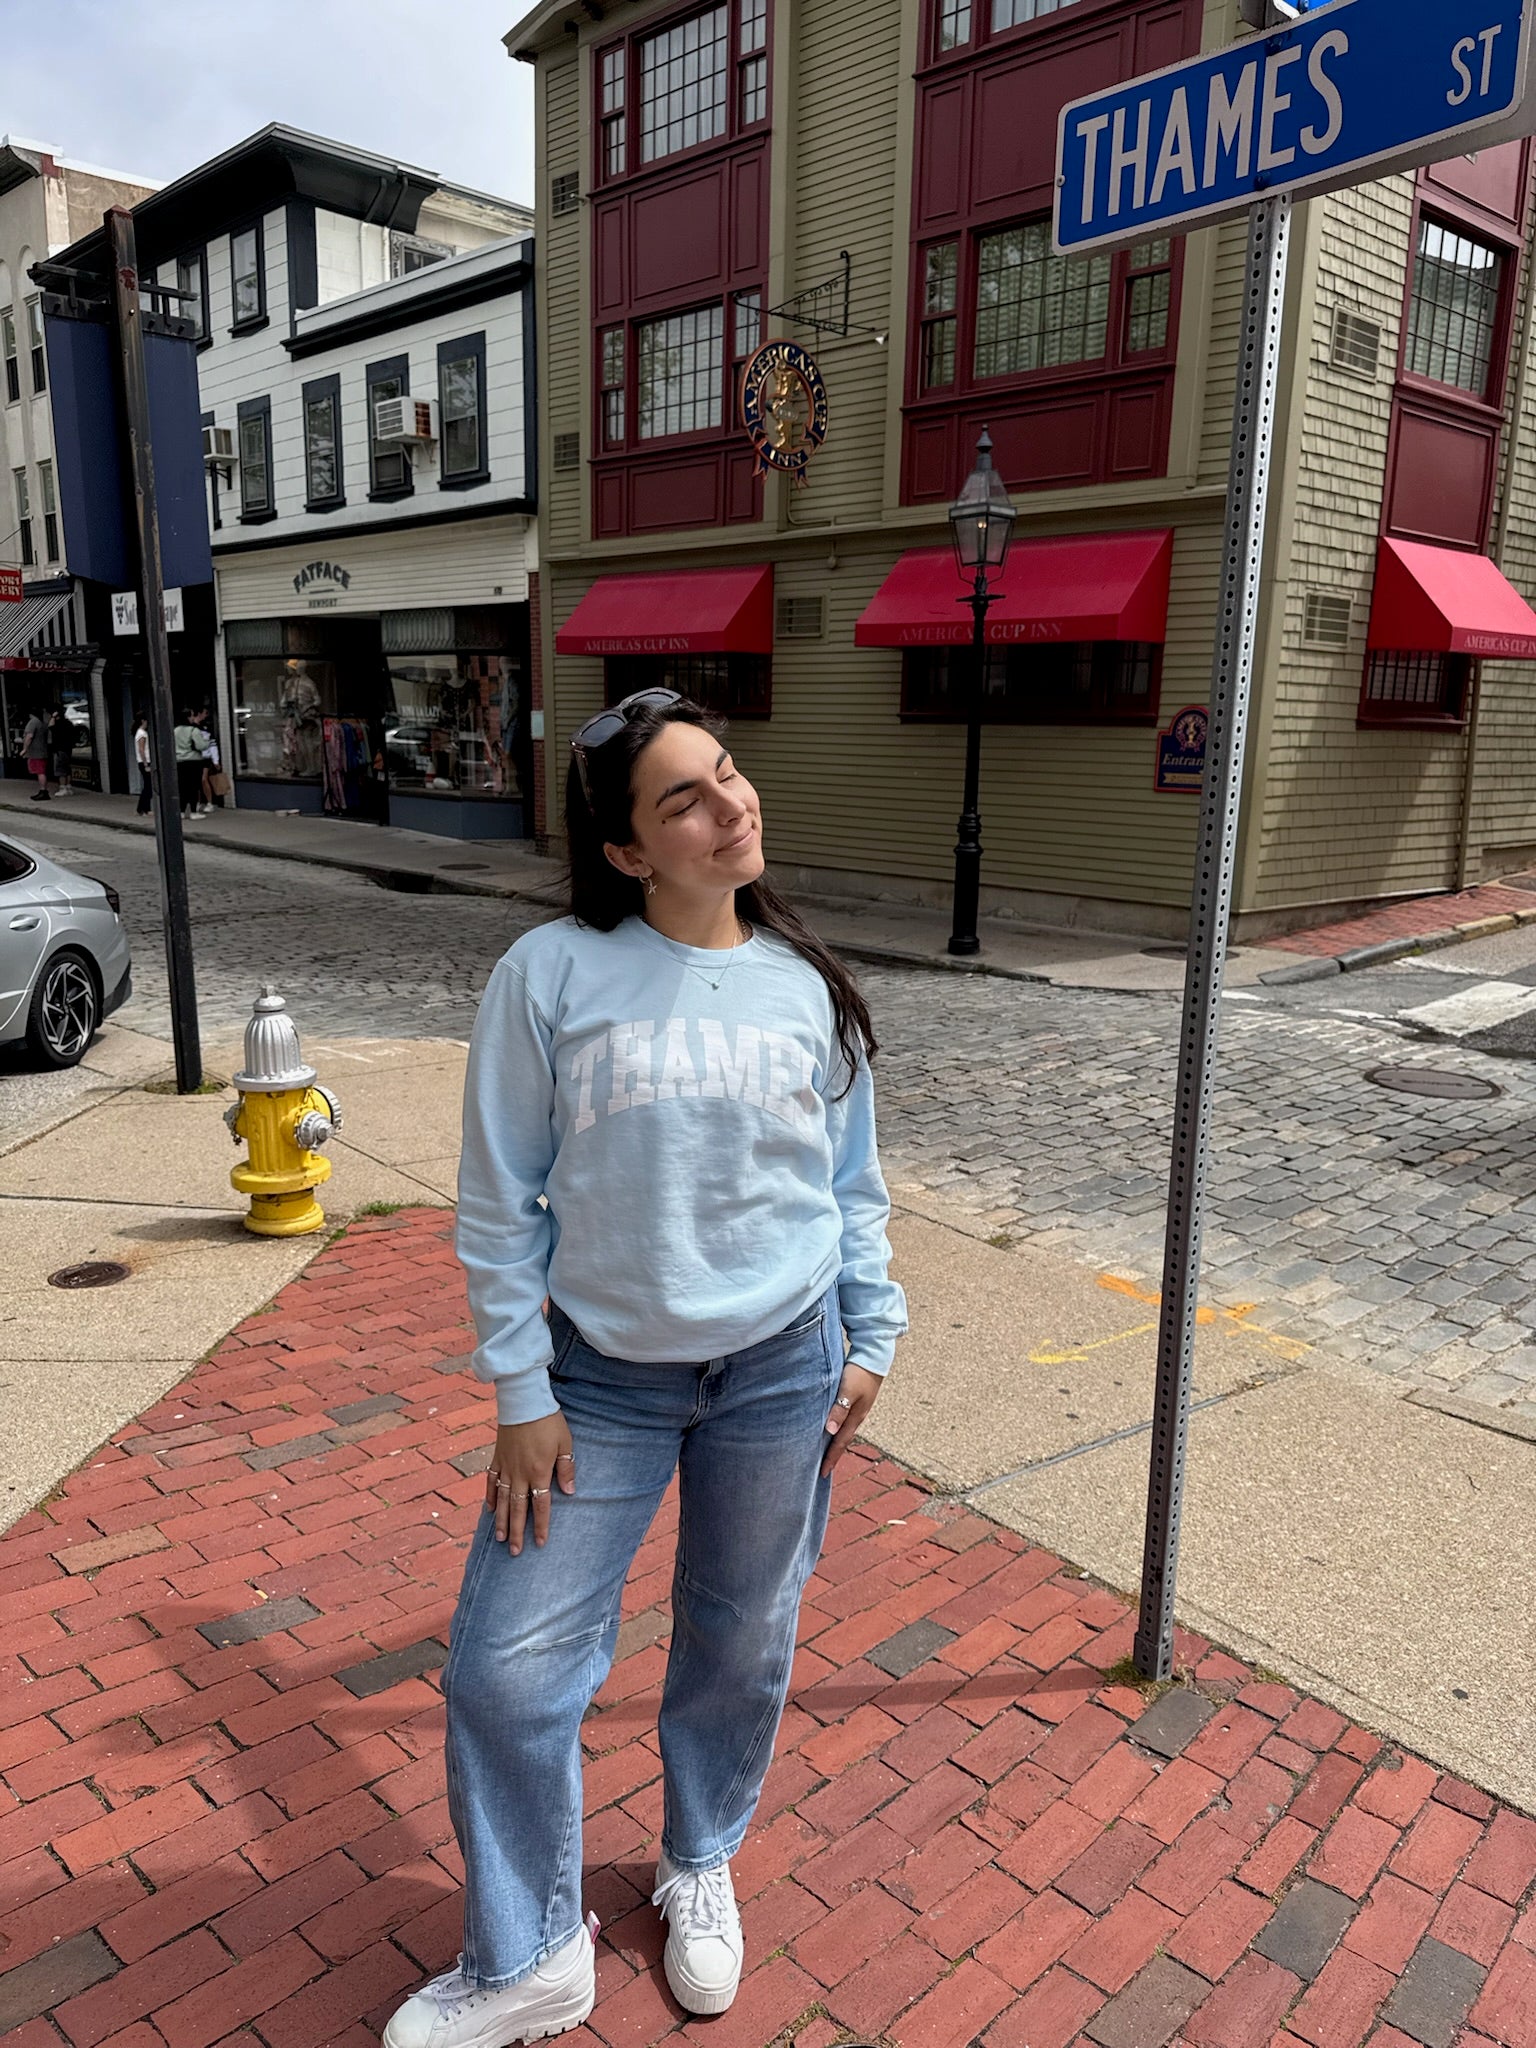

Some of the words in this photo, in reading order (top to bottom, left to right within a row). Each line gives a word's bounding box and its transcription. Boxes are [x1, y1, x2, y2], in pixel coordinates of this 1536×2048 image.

[1076, 29, 1349, 225] THAMES
[1446, 24, 1503, 106] ST
[746, 346, 817, 415] AMERICA'S
[812, 384, 827, 431] CUP
[769, 450, 803, 467] INN
[293, 561, 351, 594] FATFACE
[990, 623, 1025, 639] CUP
[1030, 622, 1064, 638] INN
[585, 638, 641, 652] AMERICA'S
[643, 638, 666, 651] CUP
[669, 637, 689, 650] INN
[1464, 634, 1509, 651] AMERICA'S
[1510, 639, 1528, 653] CUP
